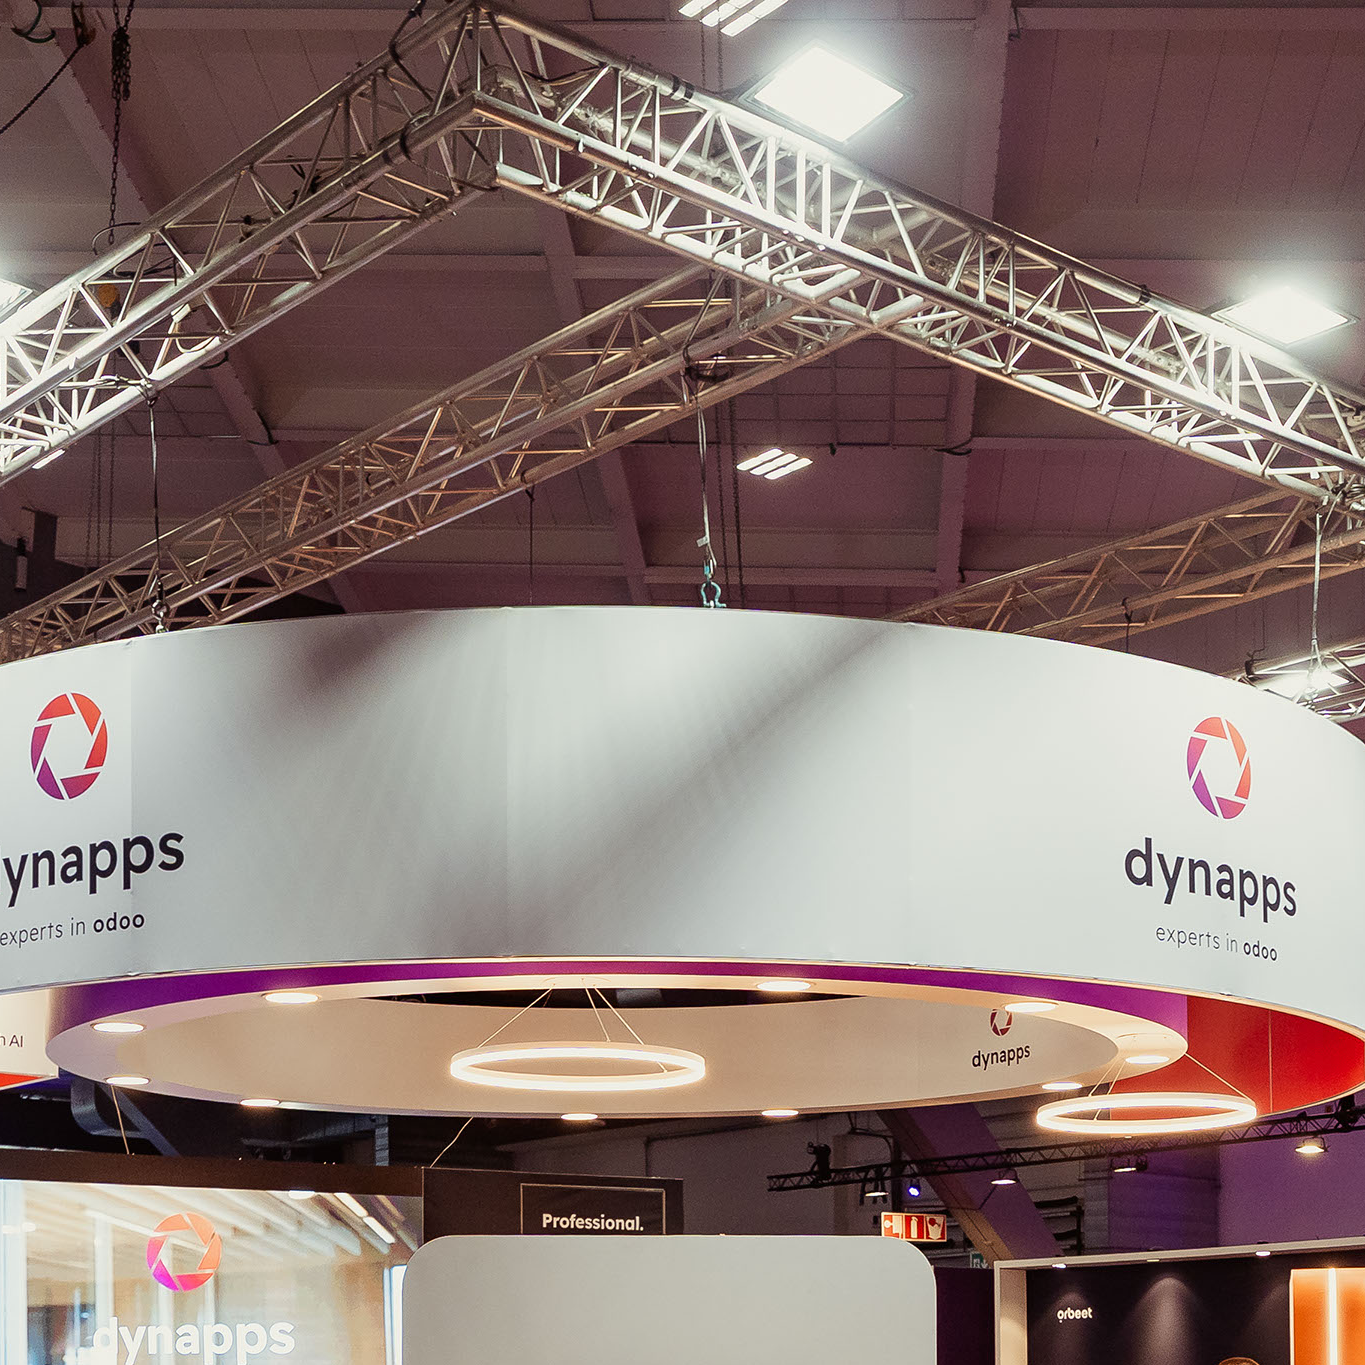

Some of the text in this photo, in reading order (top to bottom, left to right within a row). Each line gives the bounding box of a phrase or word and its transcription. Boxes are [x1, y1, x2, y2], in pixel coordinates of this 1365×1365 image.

[1124, 836, 1297, 924] dynapps
[0, 911, 145, 948] experts in odoo
[1156, 926, 1278, 961] experts in odoo
[9, 1035, 24, 1048] AI
[972, 1045, 1031, 1070] dynapps
[542, 1213, 644, 1231] Professional.
[91, 1316, 296, 1365] dynapps
